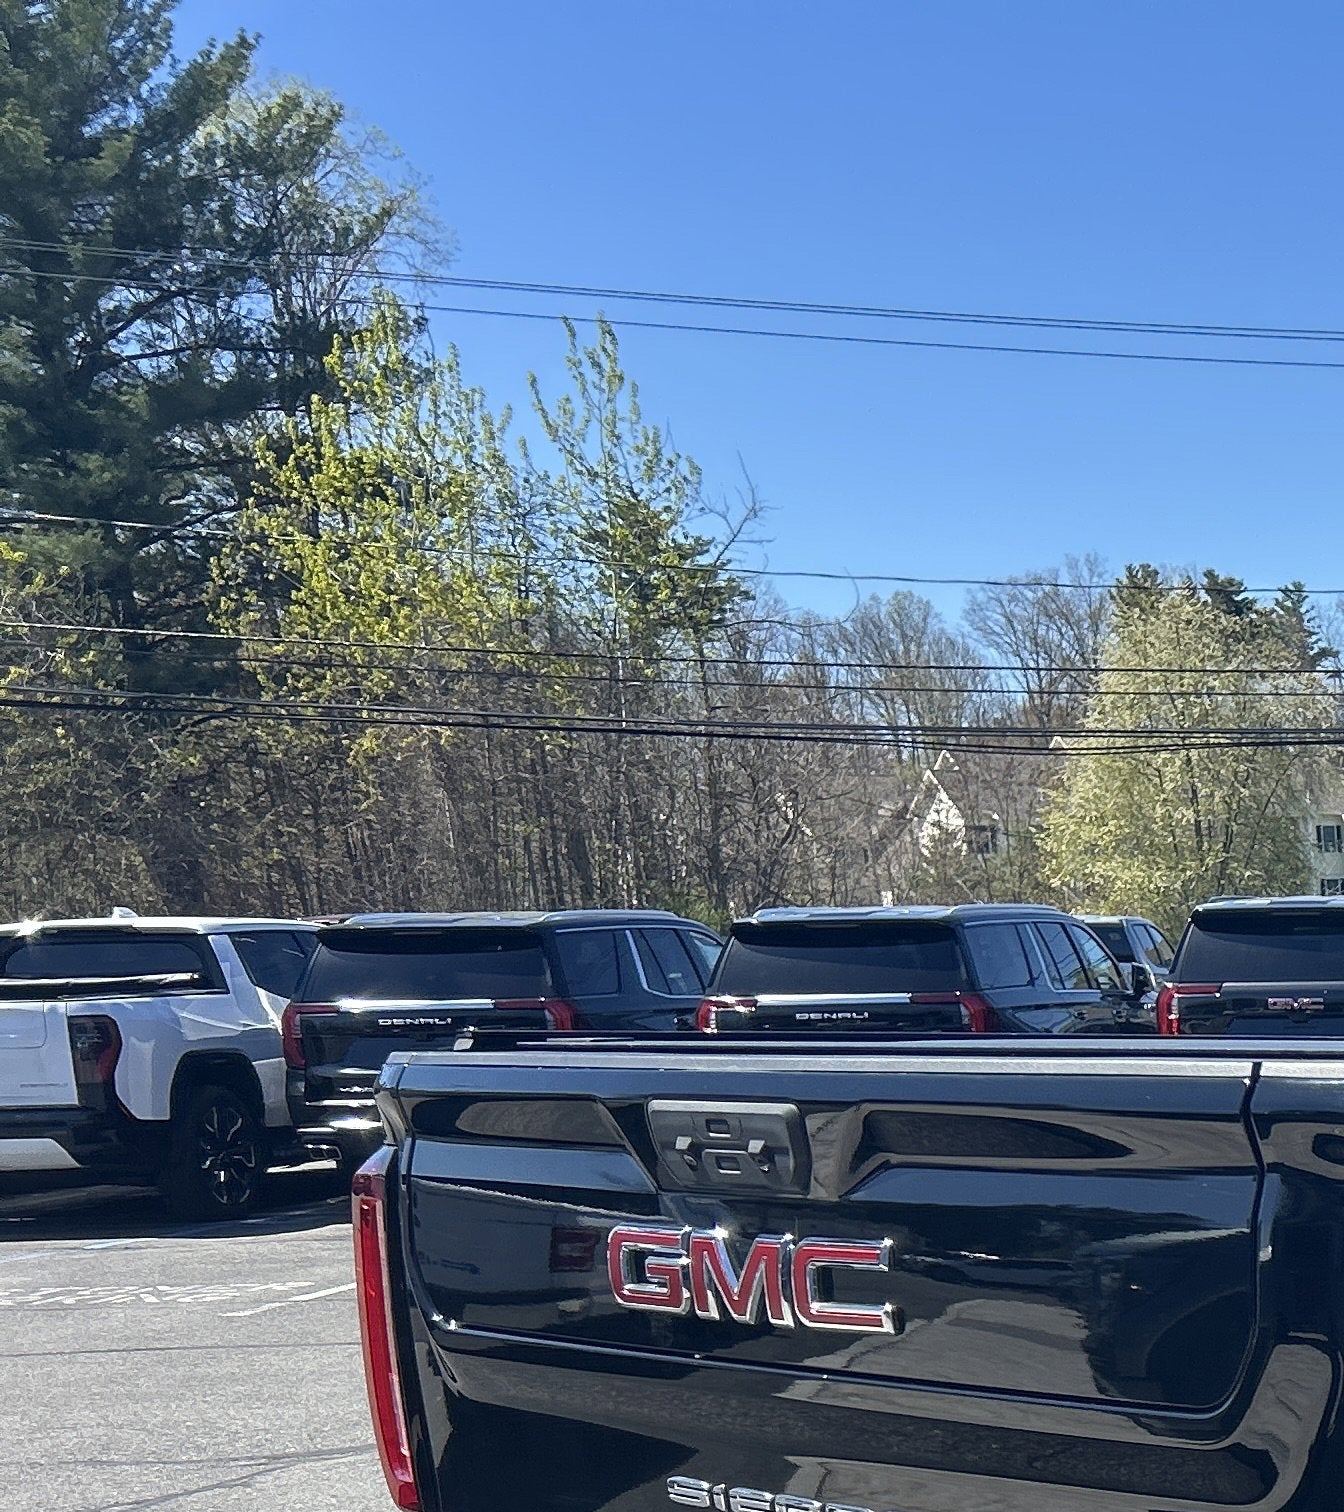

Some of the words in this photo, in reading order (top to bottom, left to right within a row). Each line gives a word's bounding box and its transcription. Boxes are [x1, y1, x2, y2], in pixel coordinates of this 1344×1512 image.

[794, 1011, 869, 1020] DENALI
[377, 1018, 452, 1026] DENALI
[607, 1223, 902, 1335] GMC
